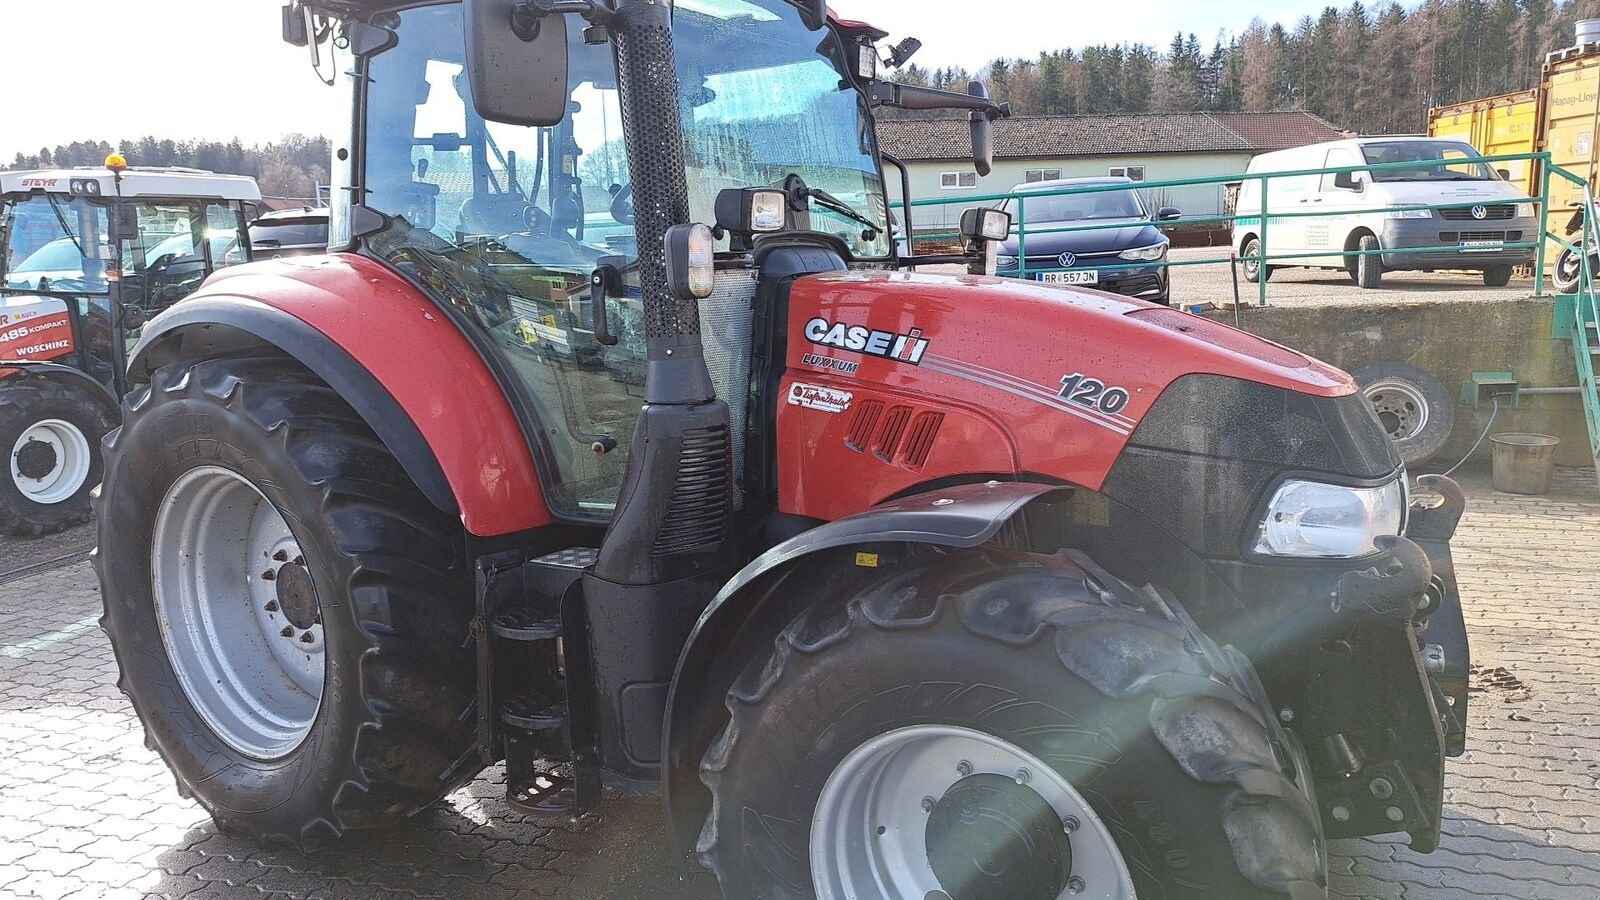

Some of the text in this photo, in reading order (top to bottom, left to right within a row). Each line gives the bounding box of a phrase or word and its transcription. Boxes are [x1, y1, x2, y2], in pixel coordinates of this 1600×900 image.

[21, 178, 58, 187] STEYR
[1045, 272, 1095, 283] BR 557 JN
[13, 310, 38, 320] MAUCH
[0, 319, 67, 342] 485 KOMPAKT
[804, 317, 893, 357] CASE
[16, 339, 69, 356] WOSCHINZ
[802, 353, 859, 373] LUXXUM
[1056, 372, 1130, 415] 120
